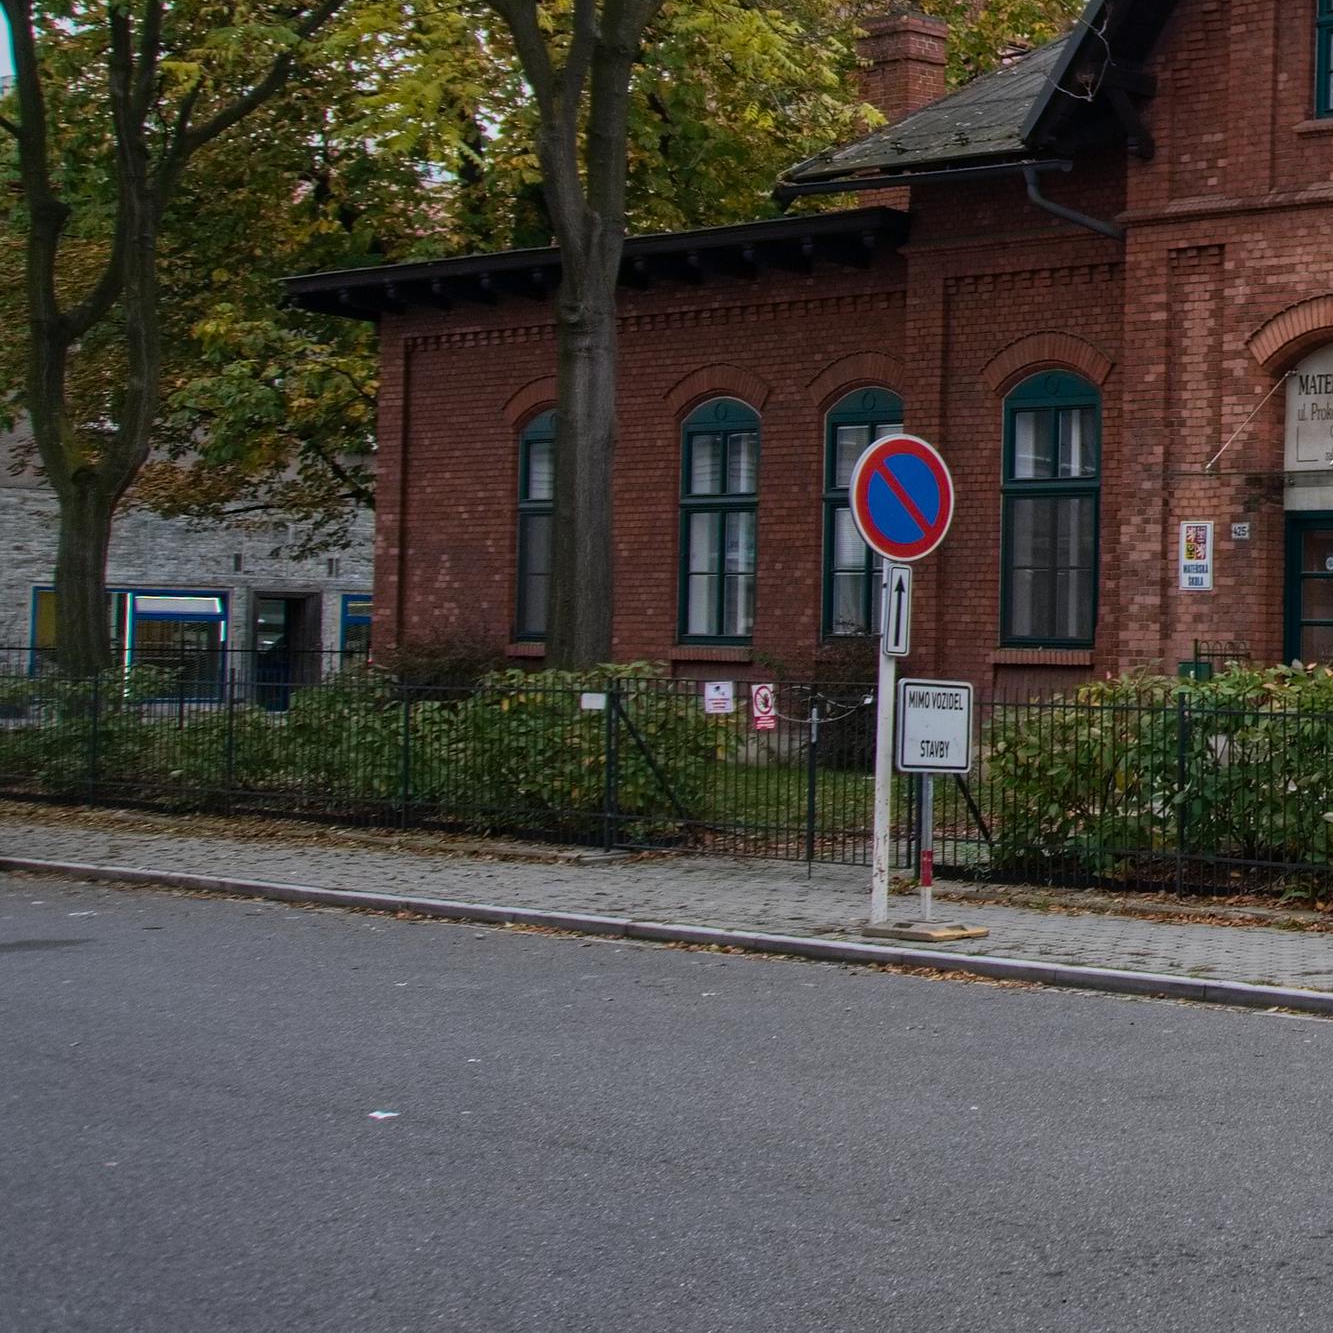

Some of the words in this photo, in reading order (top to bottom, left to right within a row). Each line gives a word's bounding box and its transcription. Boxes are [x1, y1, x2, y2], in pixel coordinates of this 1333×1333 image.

[909, 691, 930, 709] MIMO
[931, 691, 964, 711] VOZIDEL
[920, 740, 950, 759] STAVBY
